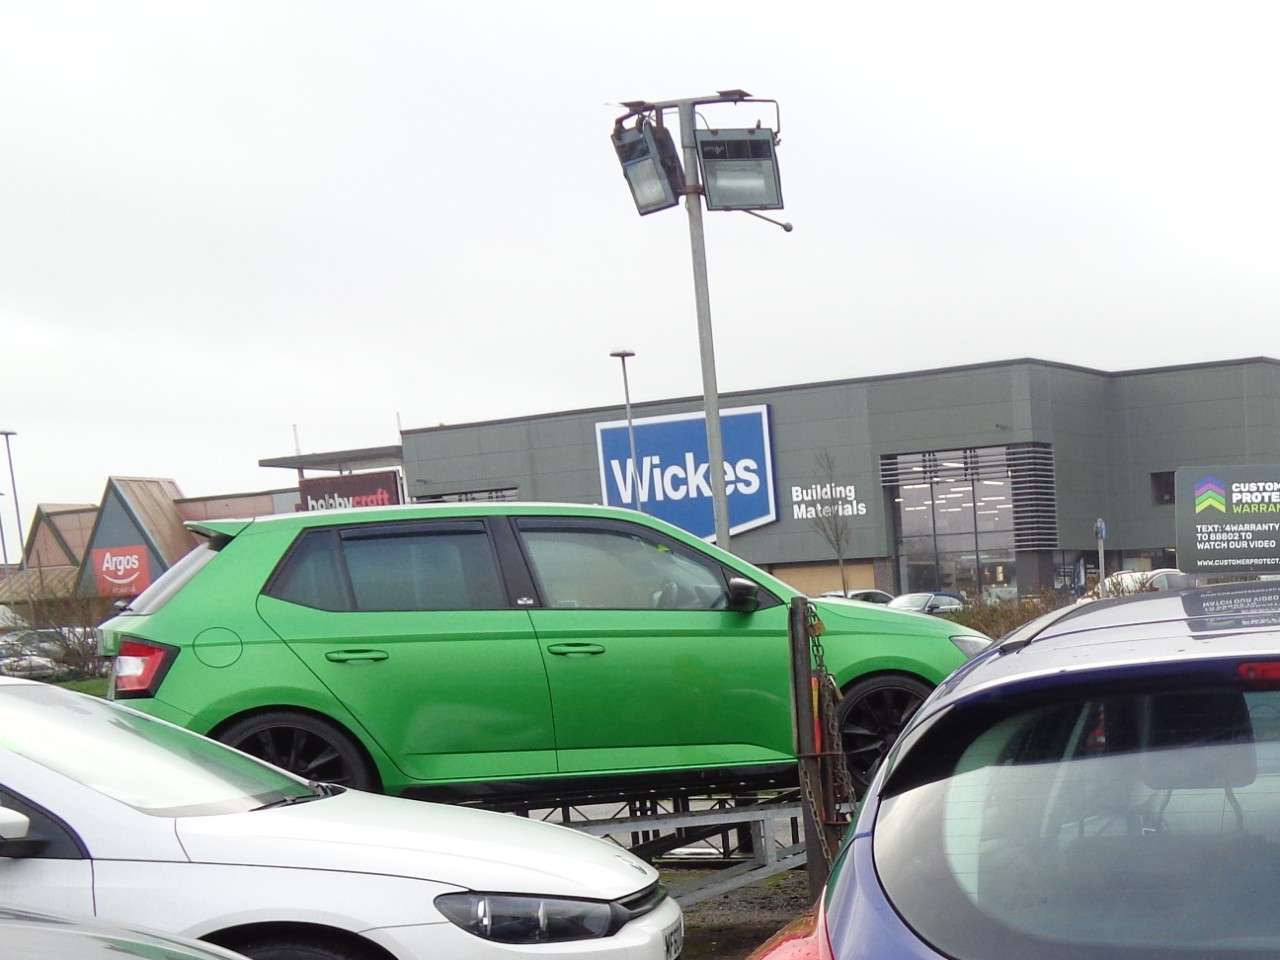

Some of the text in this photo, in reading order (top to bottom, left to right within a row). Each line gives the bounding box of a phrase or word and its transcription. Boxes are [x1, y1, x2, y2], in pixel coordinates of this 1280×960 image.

[610, 452, 760, 504] Wickes
[307, 488, 390, 511] hobbycraft
[792, 483, 855, 501] Building
[794, 500, 866, 520] Materials
[1196, 524, 1222, 533] TEXT:
[1196, 533, 1209, 541] TO
[1240, 531, 1252, 540] TO
[1197, 539, 1276, 550] WATCH OUR VIDEO
[102, 552, 139, 576] Argos
